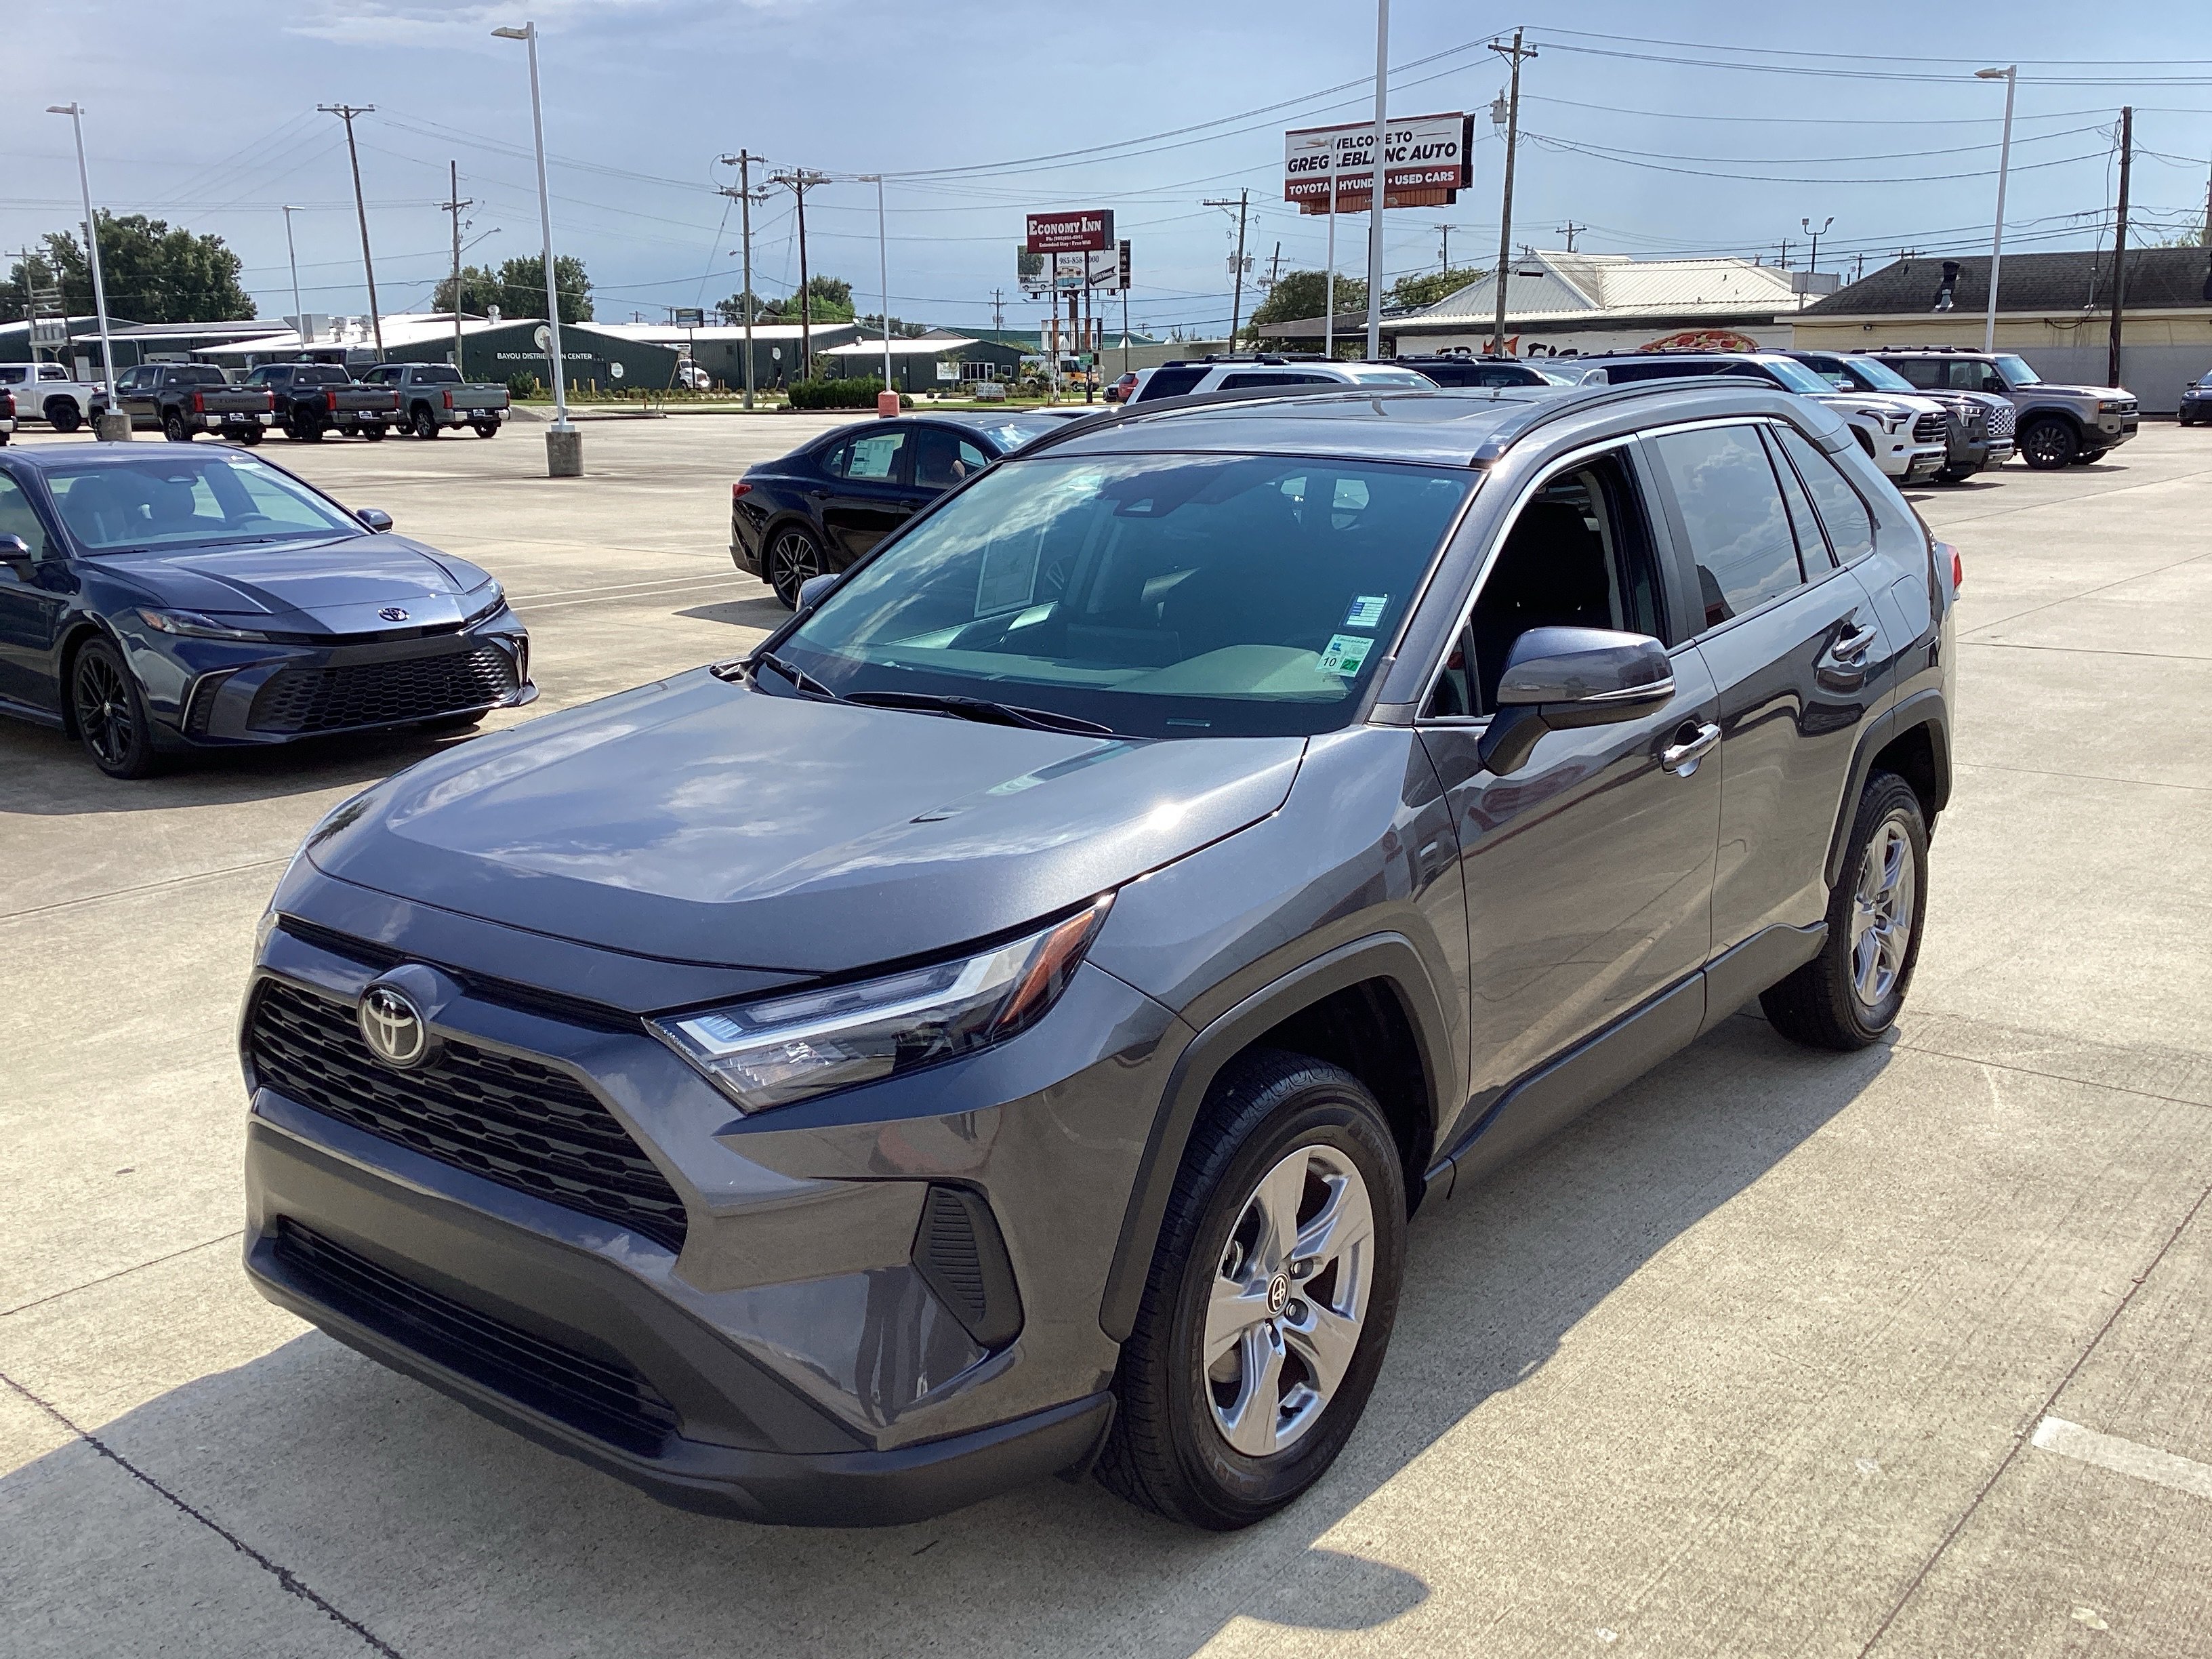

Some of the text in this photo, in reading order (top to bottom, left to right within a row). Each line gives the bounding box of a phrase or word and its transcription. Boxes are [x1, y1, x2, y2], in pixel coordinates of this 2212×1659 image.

[1336, 131, 1412, 150] ELCOE TO
[1288, 142, 1457, 172] GREG EBLNC AUTO
[1289, 171, 1454, 195] TOYOTA HYUNDI USED CARS
[1082, 217, 1101, 232] INN
[1059, 255, 1099, 265] 985-858-00
[1324, 657, 1361, 670] 10 27
